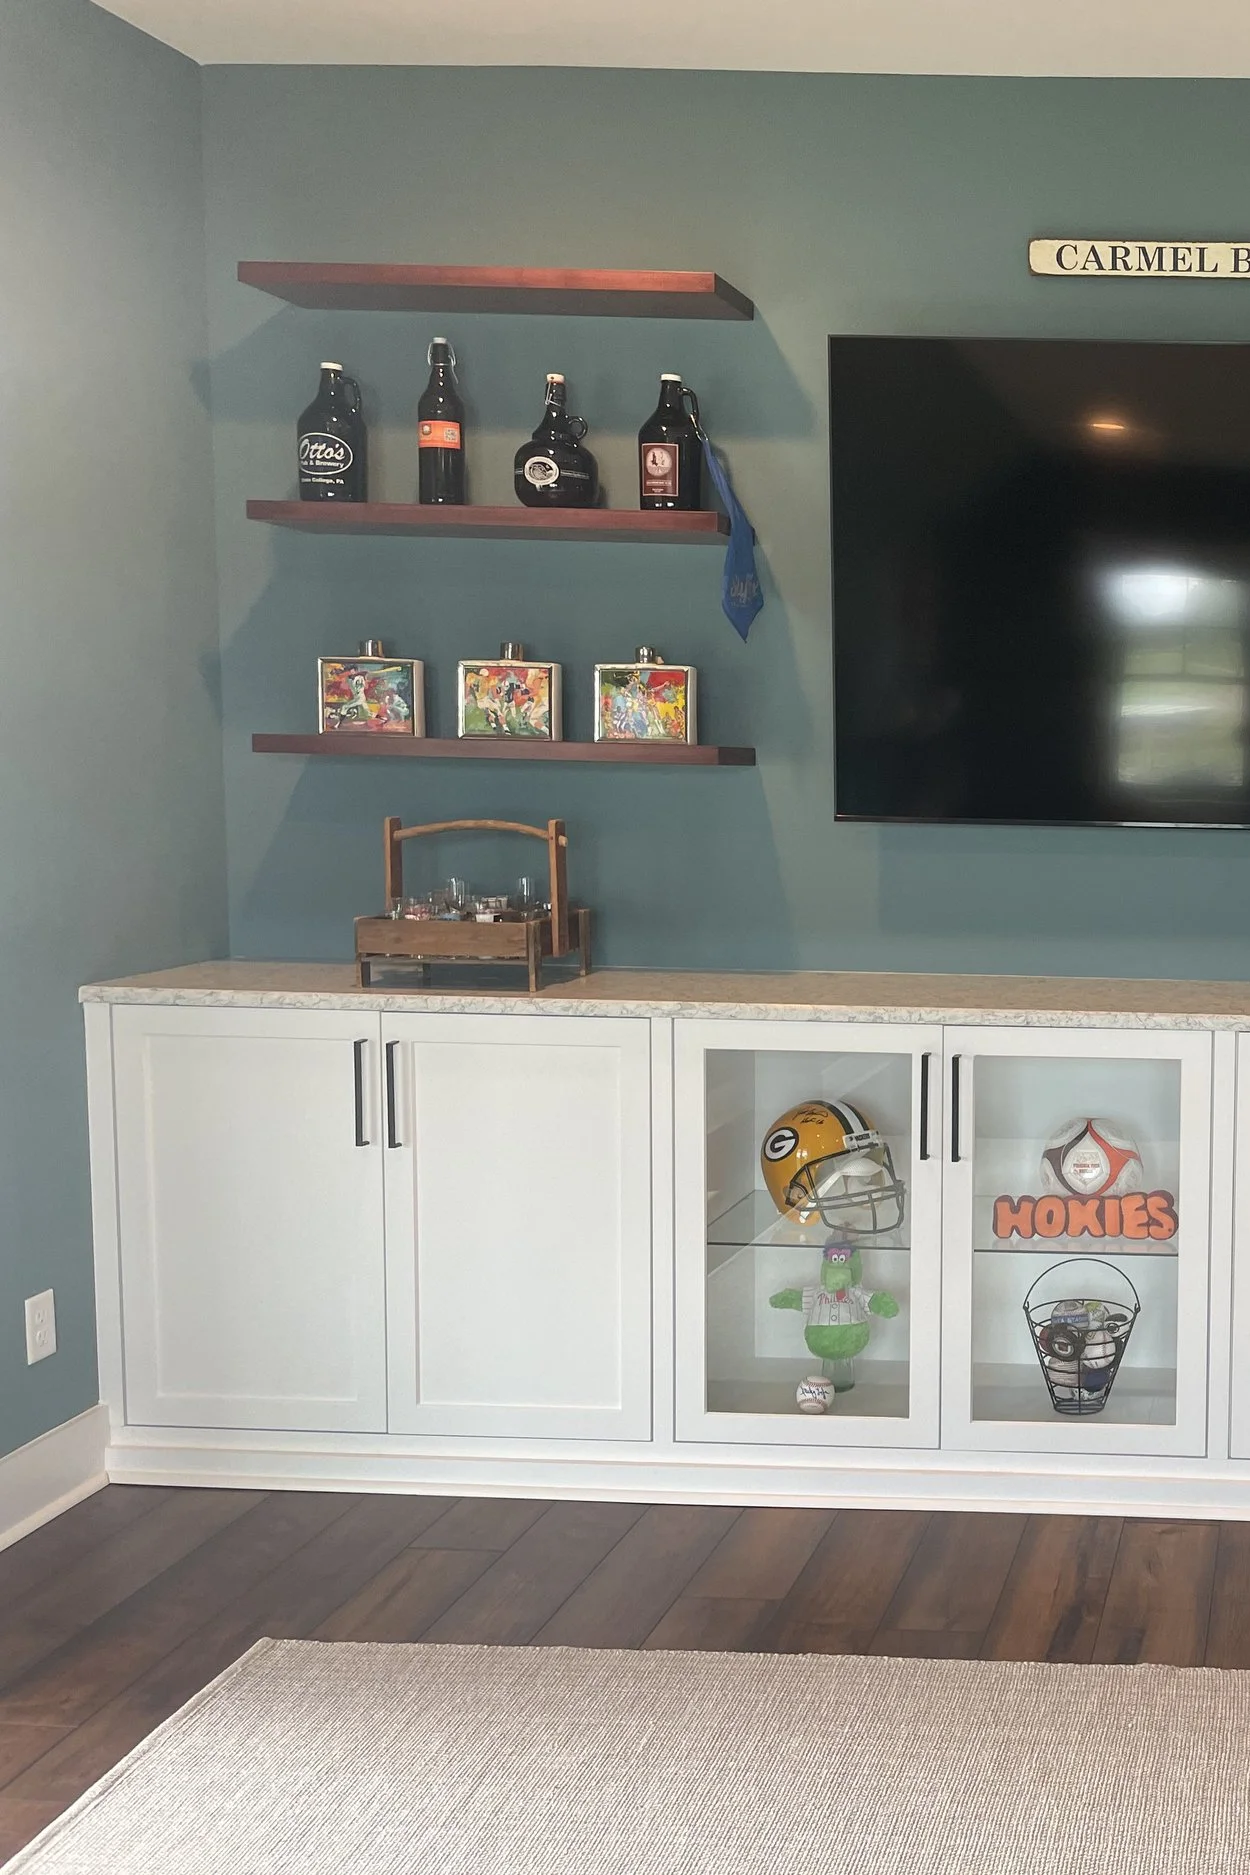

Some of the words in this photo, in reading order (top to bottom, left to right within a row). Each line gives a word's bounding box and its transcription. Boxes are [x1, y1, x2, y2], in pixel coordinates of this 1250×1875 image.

[1056, 244, 1219, 273] CARMEL
[300, 439, 346, 460] Otto's
[315, 460, 345, 469] Brewery
[763, 1128, 798, 1162] G
[992, 1190, 1179, 1240] HOKIES
